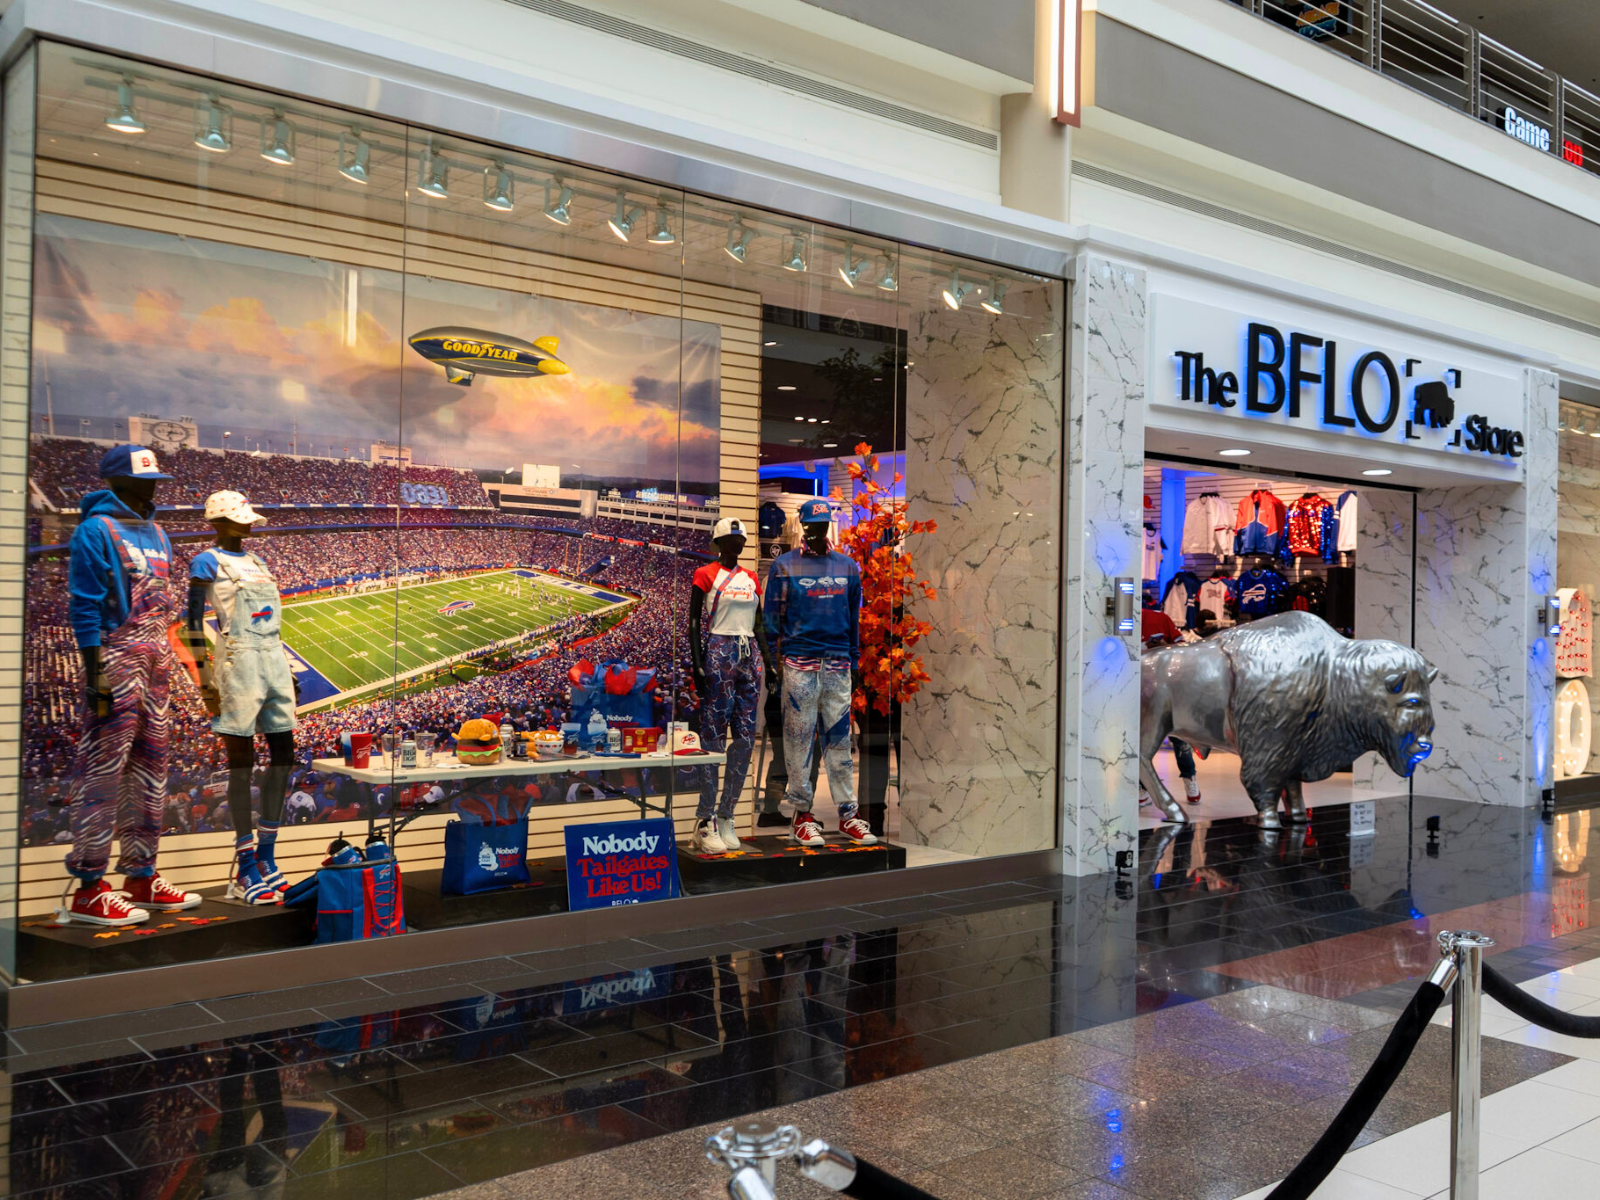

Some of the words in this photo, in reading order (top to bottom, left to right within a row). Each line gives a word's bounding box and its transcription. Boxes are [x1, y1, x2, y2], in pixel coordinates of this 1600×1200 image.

[442, 340, 519, 361] GOODYEAR
[1174, 350, 1239, 408] The
[1246, 322, 1400, 434] BFLO
[1465, 414, 1525, 458] Store
[606, 714, 634, 722] Nobody
[582, 831, 660, 856] Nobody
[576, 853, 669, 877] Tailgates
[587, 876, 630, 898] Like
[631, 871, 662, 893] Us!
